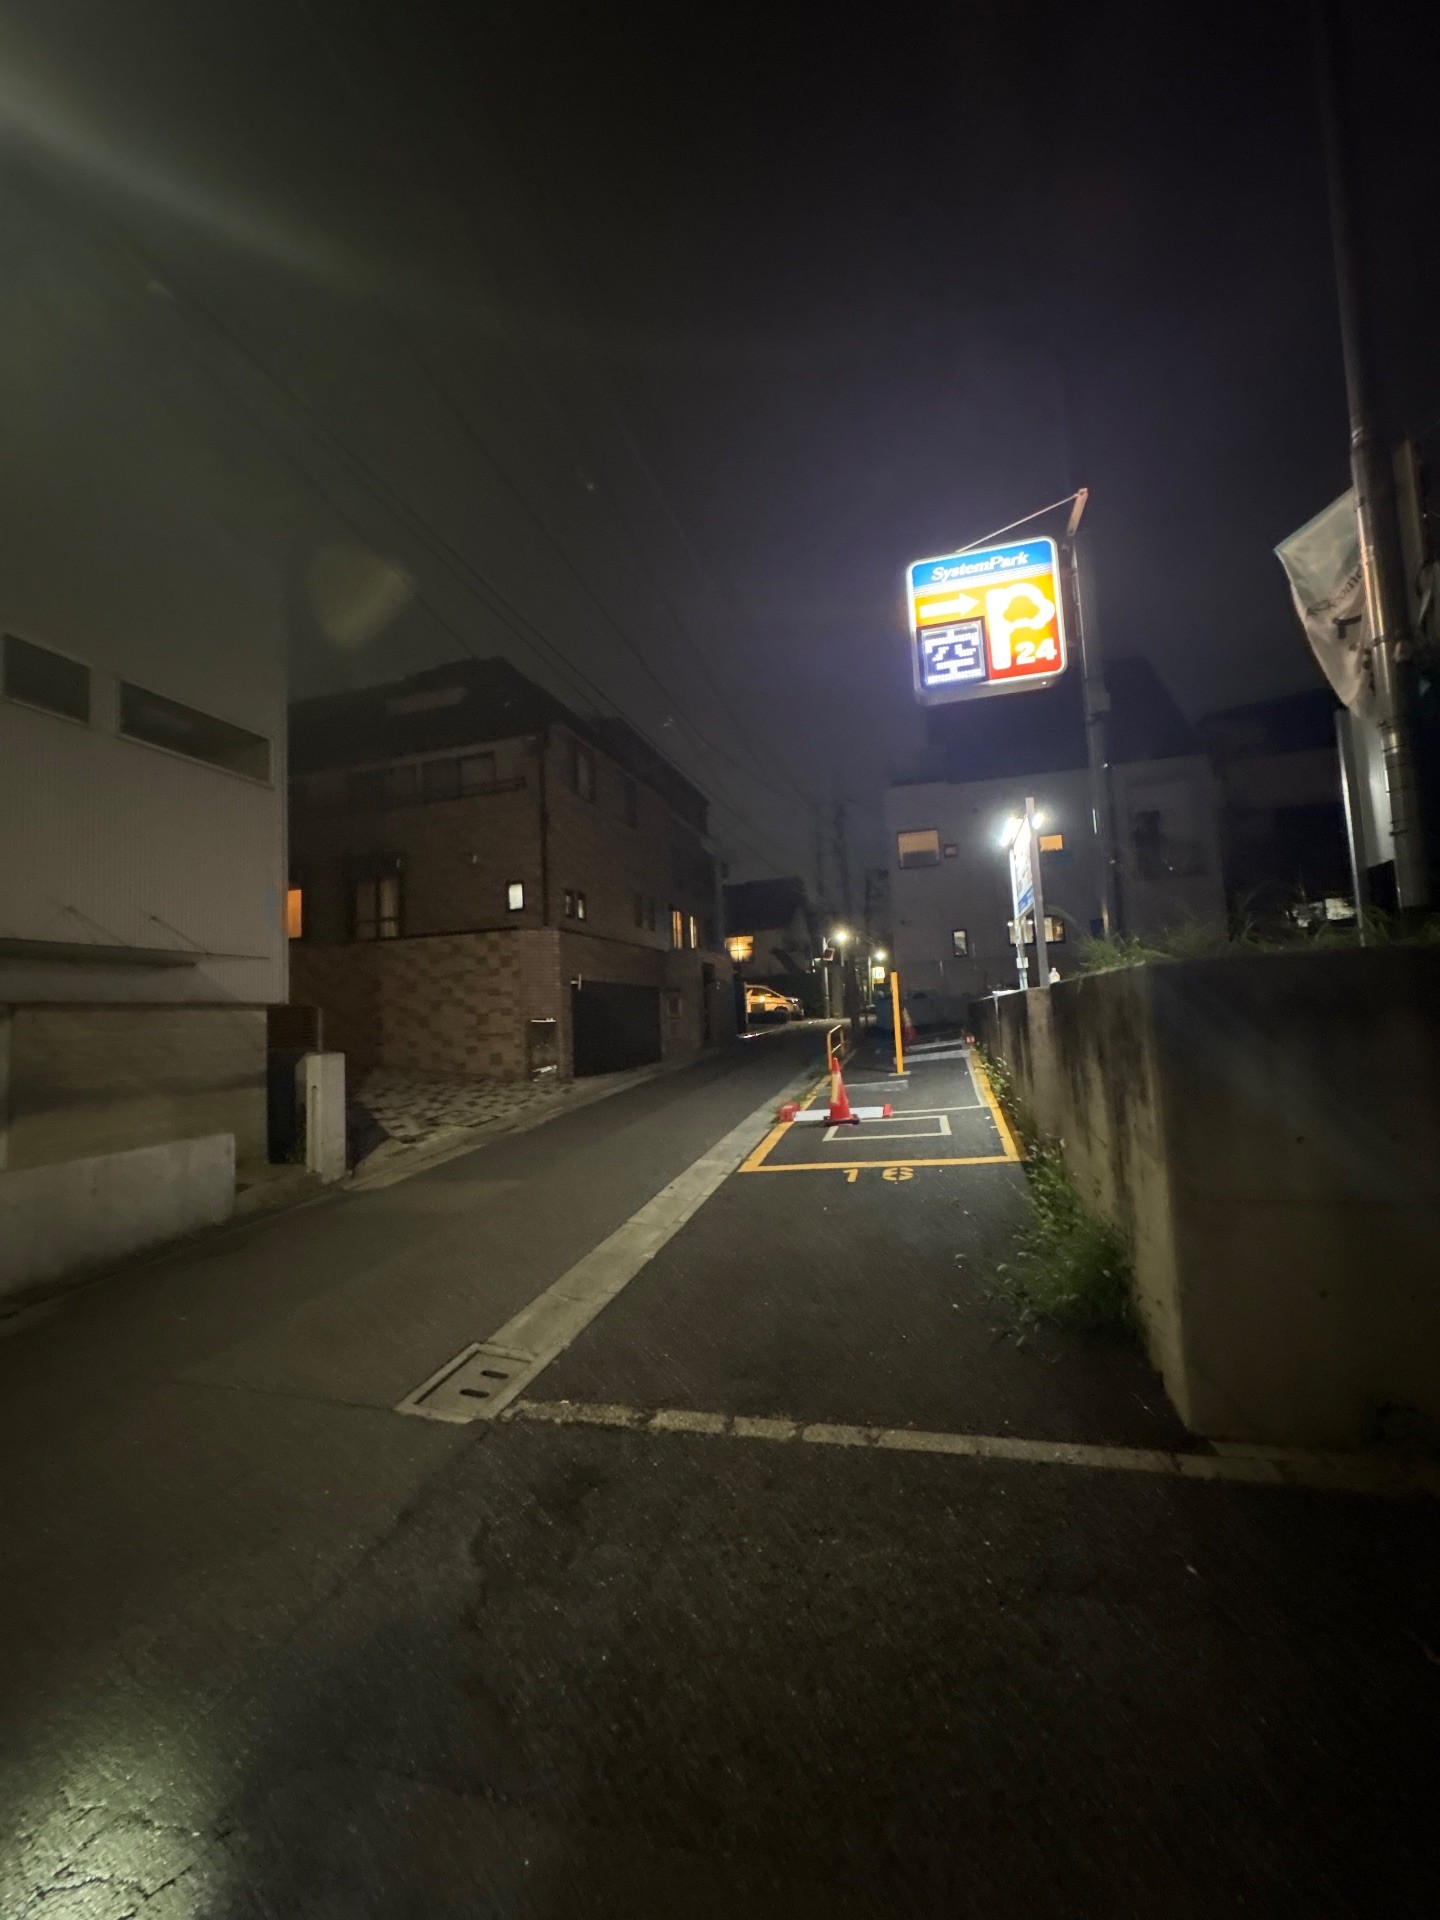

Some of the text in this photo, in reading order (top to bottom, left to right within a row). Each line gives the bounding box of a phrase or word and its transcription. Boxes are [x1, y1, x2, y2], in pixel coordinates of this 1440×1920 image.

[921, 628, 982, 685] 空
[1015, 638, 1057, 666] 24
[843, 1167, 914, 1183] 16
